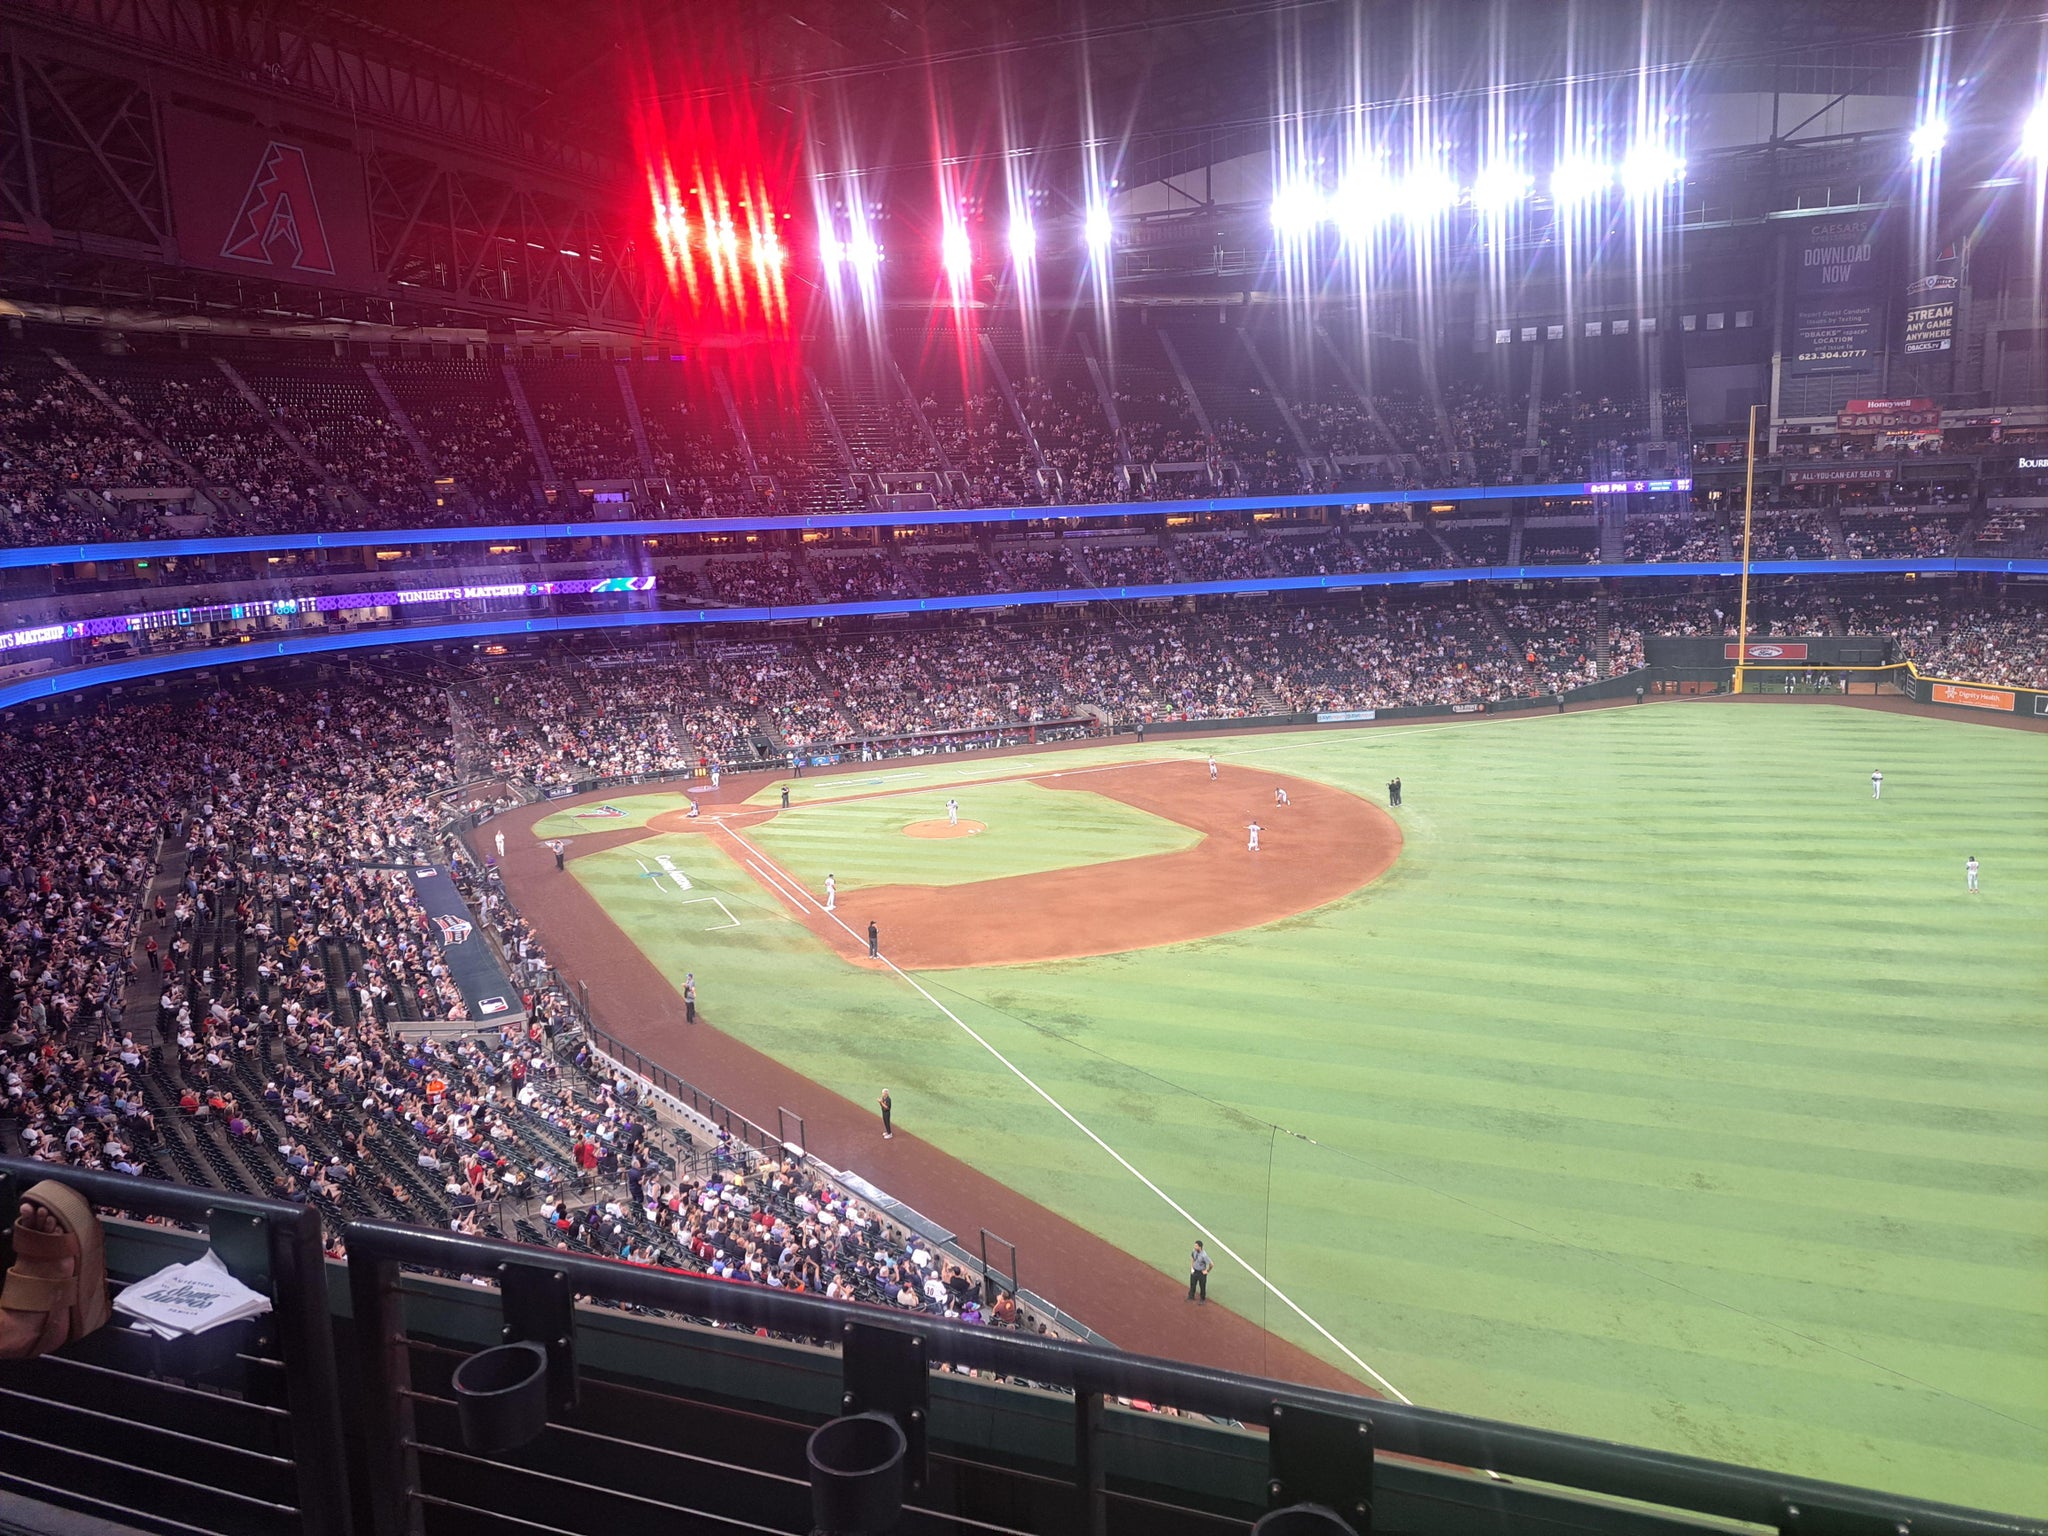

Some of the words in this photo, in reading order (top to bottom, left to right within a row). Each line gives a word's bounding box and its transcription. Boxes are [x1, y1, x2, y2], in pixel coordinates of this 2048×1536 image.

[1811, 222, 1867, 235] CAESARS
[1804, 244, 1871, 266] DOWNLOAD
[1822, 264, 1851, 283] NOW
[1907, 306, 1953, 322] STREAM
[1906, 321, 1924, 332] ANY
[1926, 318, 1952, 329] GAME
[1813, 336, 1853, 344] LOCATION
[1906, 328, 1952, 341] ANYWHERE
[1798, 349, 1867, 361] 623.304.0777
[1867, 400, 1911, 409] Honeywell
[1841, 413, 1937, 427] SANDLOT
[1802, 470, 1859, 480] ALL-YOU-CAN-EAT
[1859, 470, 1881, 479] SEATS
[1611, 483, 1627, 492] PM
[398, 587, 461, 602] TONIGHT'S
[463, 584, 526, 599] MATCHUP
[14, 626, 65, 645] MATCHUP
[1958, 690, 1980, 700] Dignity
[1980, 693, 2000, 702] Health
[141, 1289, 214, 1309] burros
